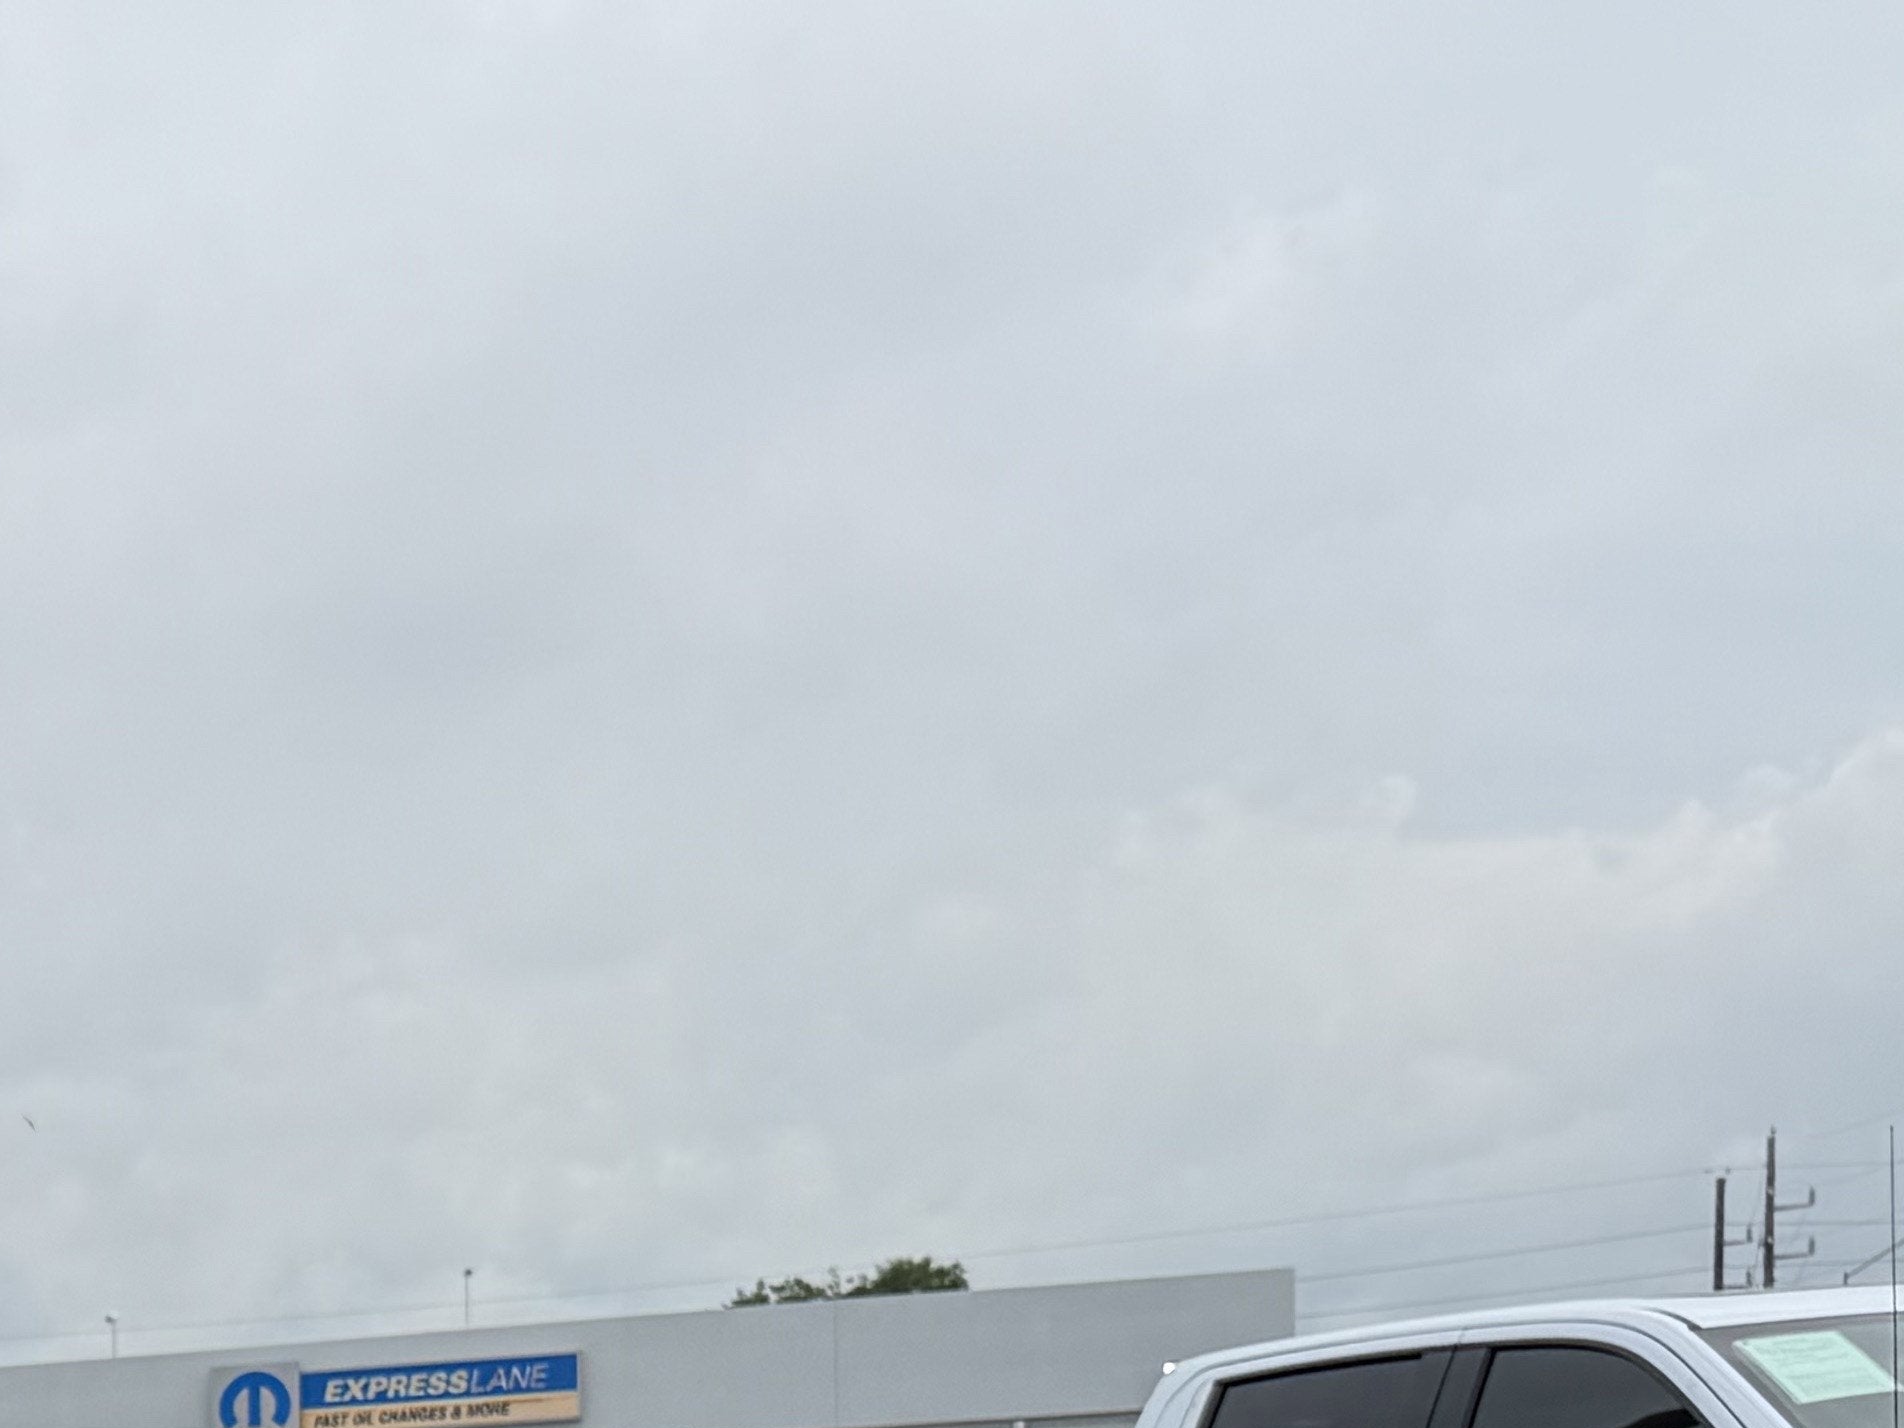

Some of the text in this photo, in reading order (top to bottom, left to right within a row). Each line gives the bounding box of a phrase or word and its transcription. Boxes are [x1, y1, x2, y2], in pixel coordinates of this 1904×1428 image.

[314, 1401, 512, 1428] FAST OIL CHANGES & MORE
